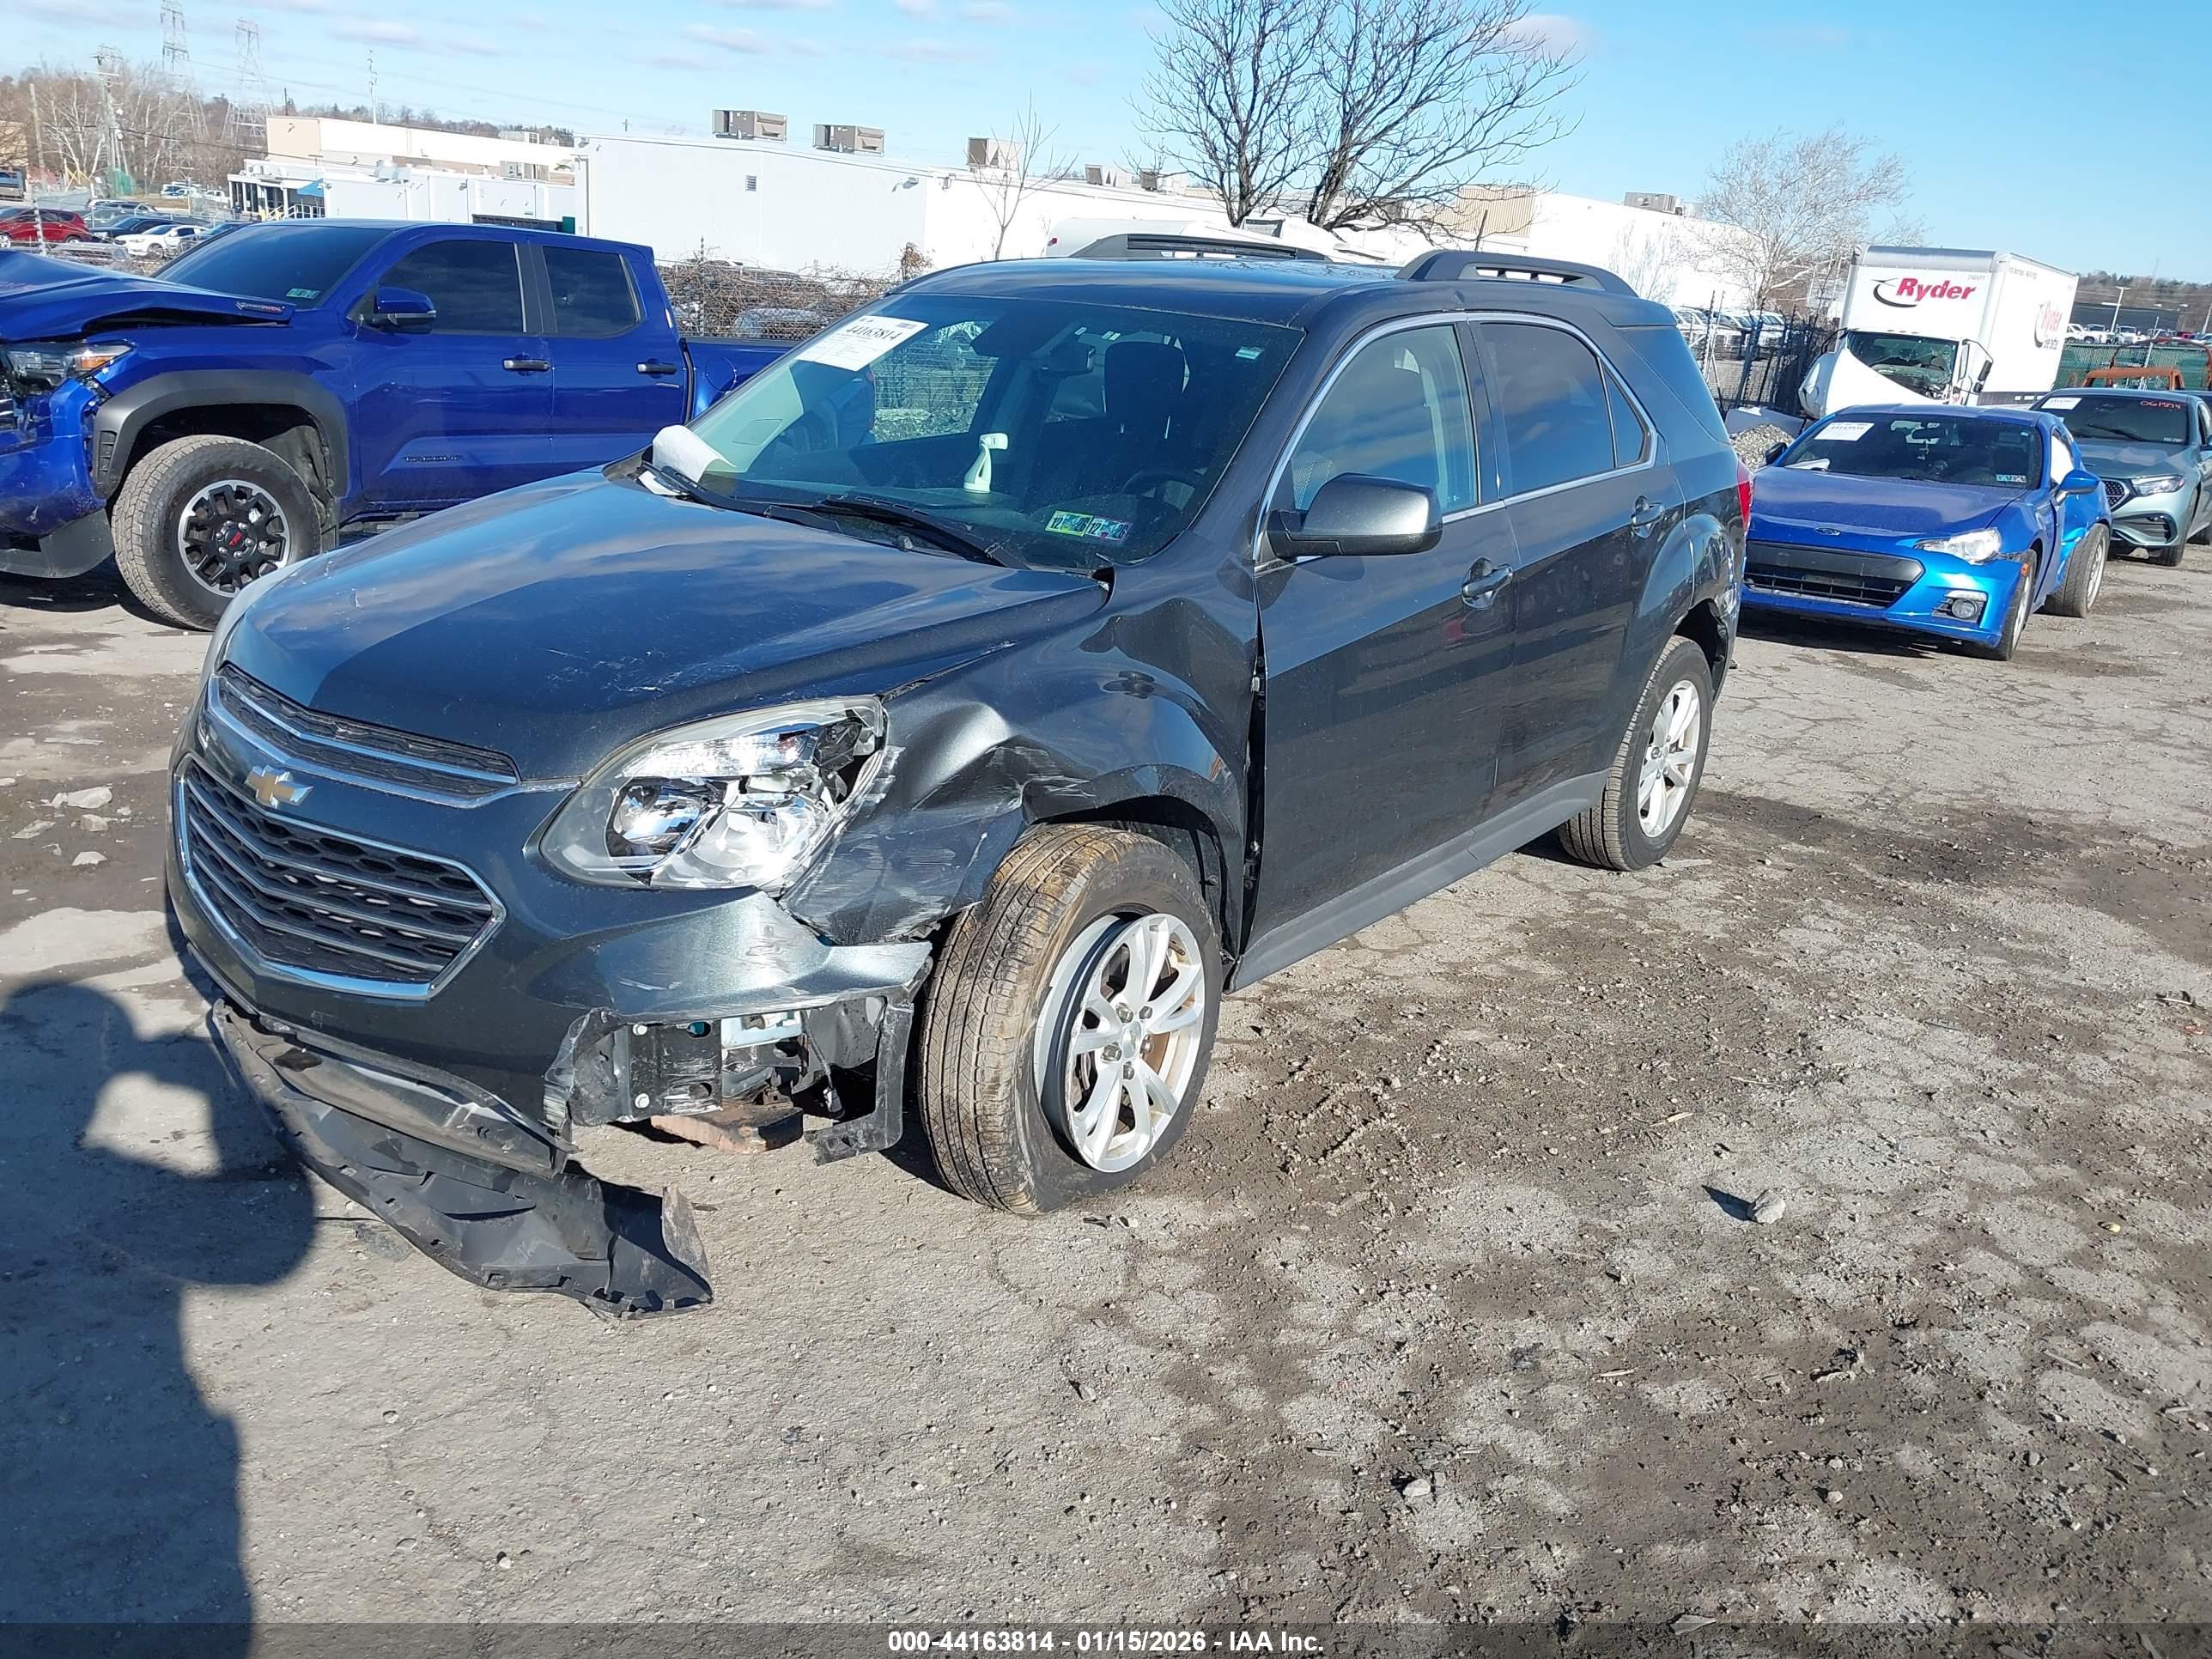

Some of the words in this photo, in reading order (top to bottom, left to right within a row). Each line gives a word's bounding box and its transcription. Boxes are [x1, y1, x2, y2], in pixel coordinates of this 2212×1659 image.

[1895, 277, 1977, 302] Ryder
[846, 325, 903, 341] 44163814
[1050, 517, 1065, 530] 12
[1088, 522, 1103, 535] 12
